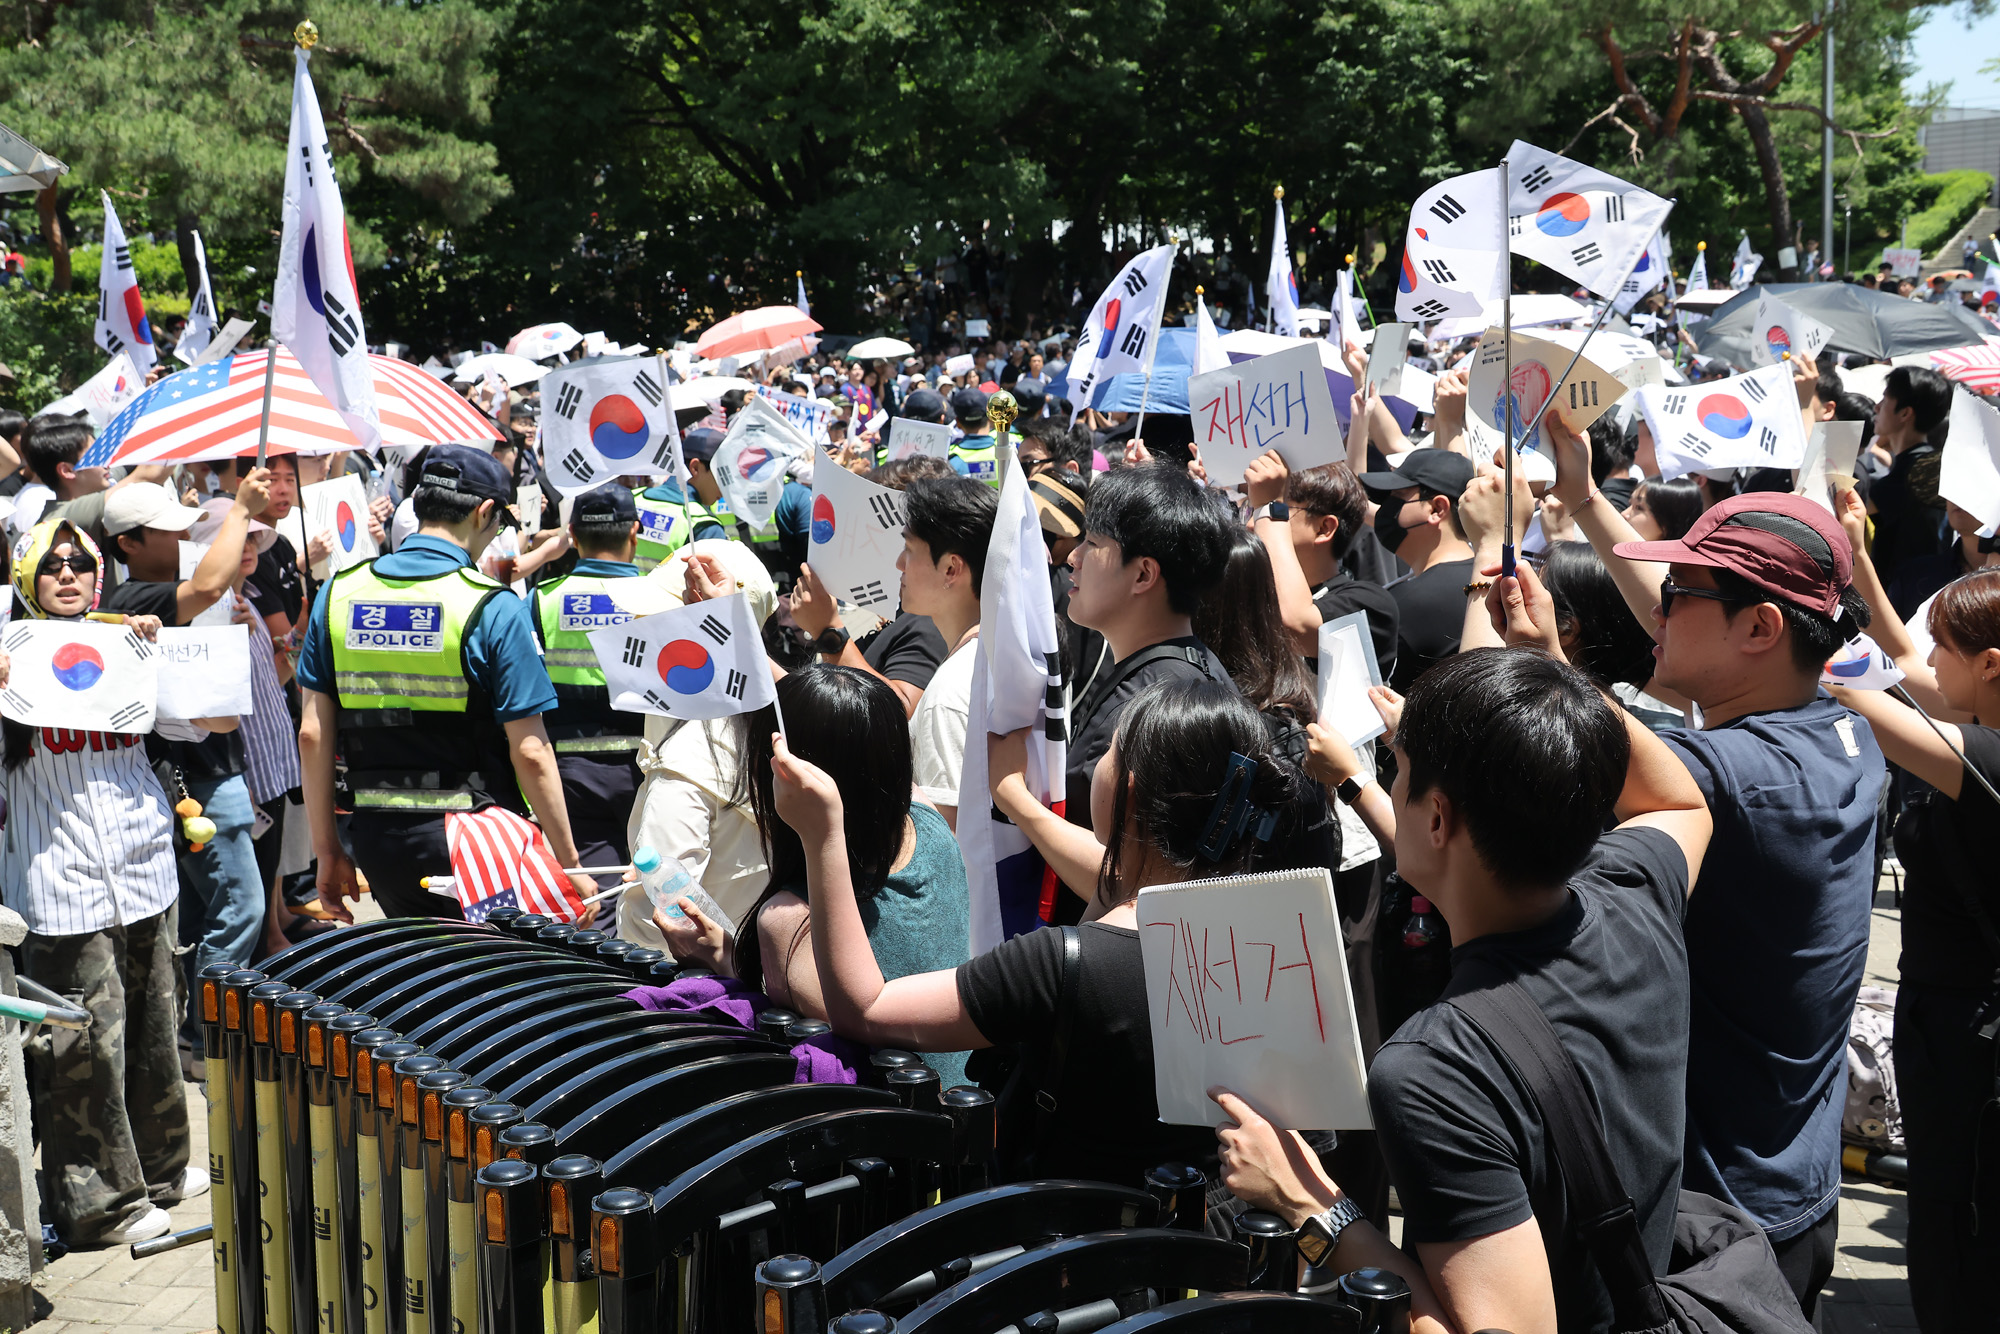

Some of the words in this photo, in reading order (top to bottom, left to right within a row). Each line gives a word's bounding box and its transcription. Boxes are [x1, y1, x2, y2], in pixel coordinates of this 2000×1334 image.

[1199, 370, 1309, 449] 재선거
[896, 429, 936, 453] 재선거
[423, 474, 453, 487] POLICE
[358, 633, 434, 647] POLICE
[157, 642, 210, 663] 재선거
[1145, 912, 1326, 1046] 재선거
